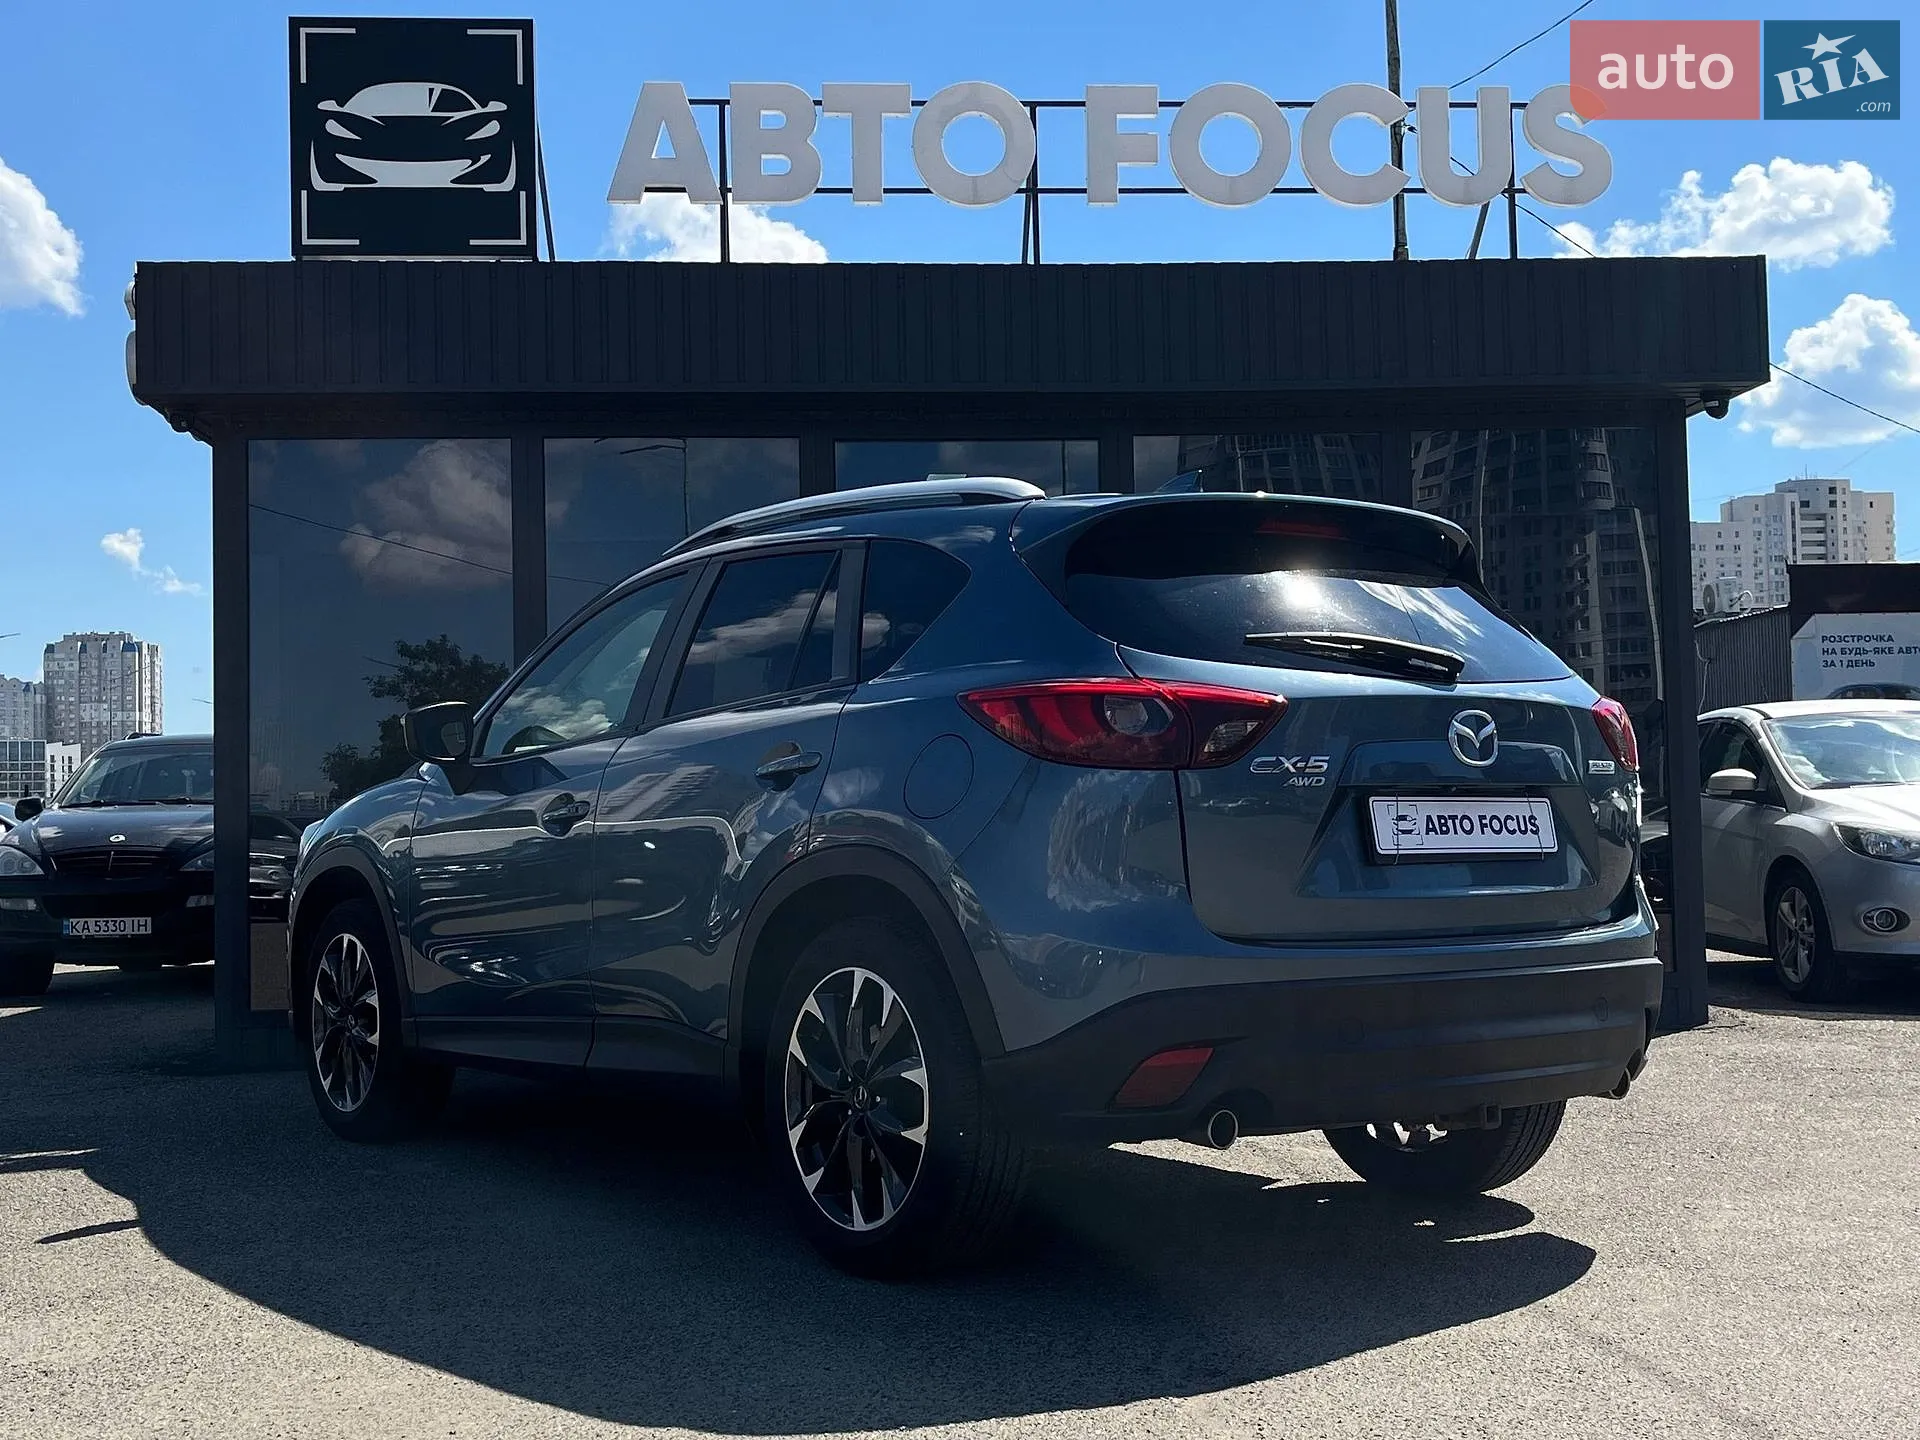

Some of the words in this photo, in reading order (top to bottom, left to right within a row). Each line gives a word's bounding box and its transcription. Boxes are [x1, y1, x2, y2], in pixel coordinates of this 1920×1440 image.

[606, 80, 1037, 207] АВТО
[1085, 81, 1614, 208] FOCUS
[1821, 634, 1894, 643] РОЗСТРОЧКА
[1822, 647, 1838, 656] НА
[1840, 646, 1894, 656] БУДЬ-ЯКЕ
[1897, 646, 1920, 655] АВТ
[1822, 659, 1837, 668] ЗА
[1846, 659, 1875, 668] ДЕНЬ
[1250, 755, 1330, 774] CX-5
[1282, 776, 1326, 787] AWD
[1425, 814, 1475, 836] АВТО
[1478, 814, 1540, 836] FOCUS
[71, 920, 91, 933] KA
[94, 919, 127, 933] 5330
[131, 919, 148, 932] IH
